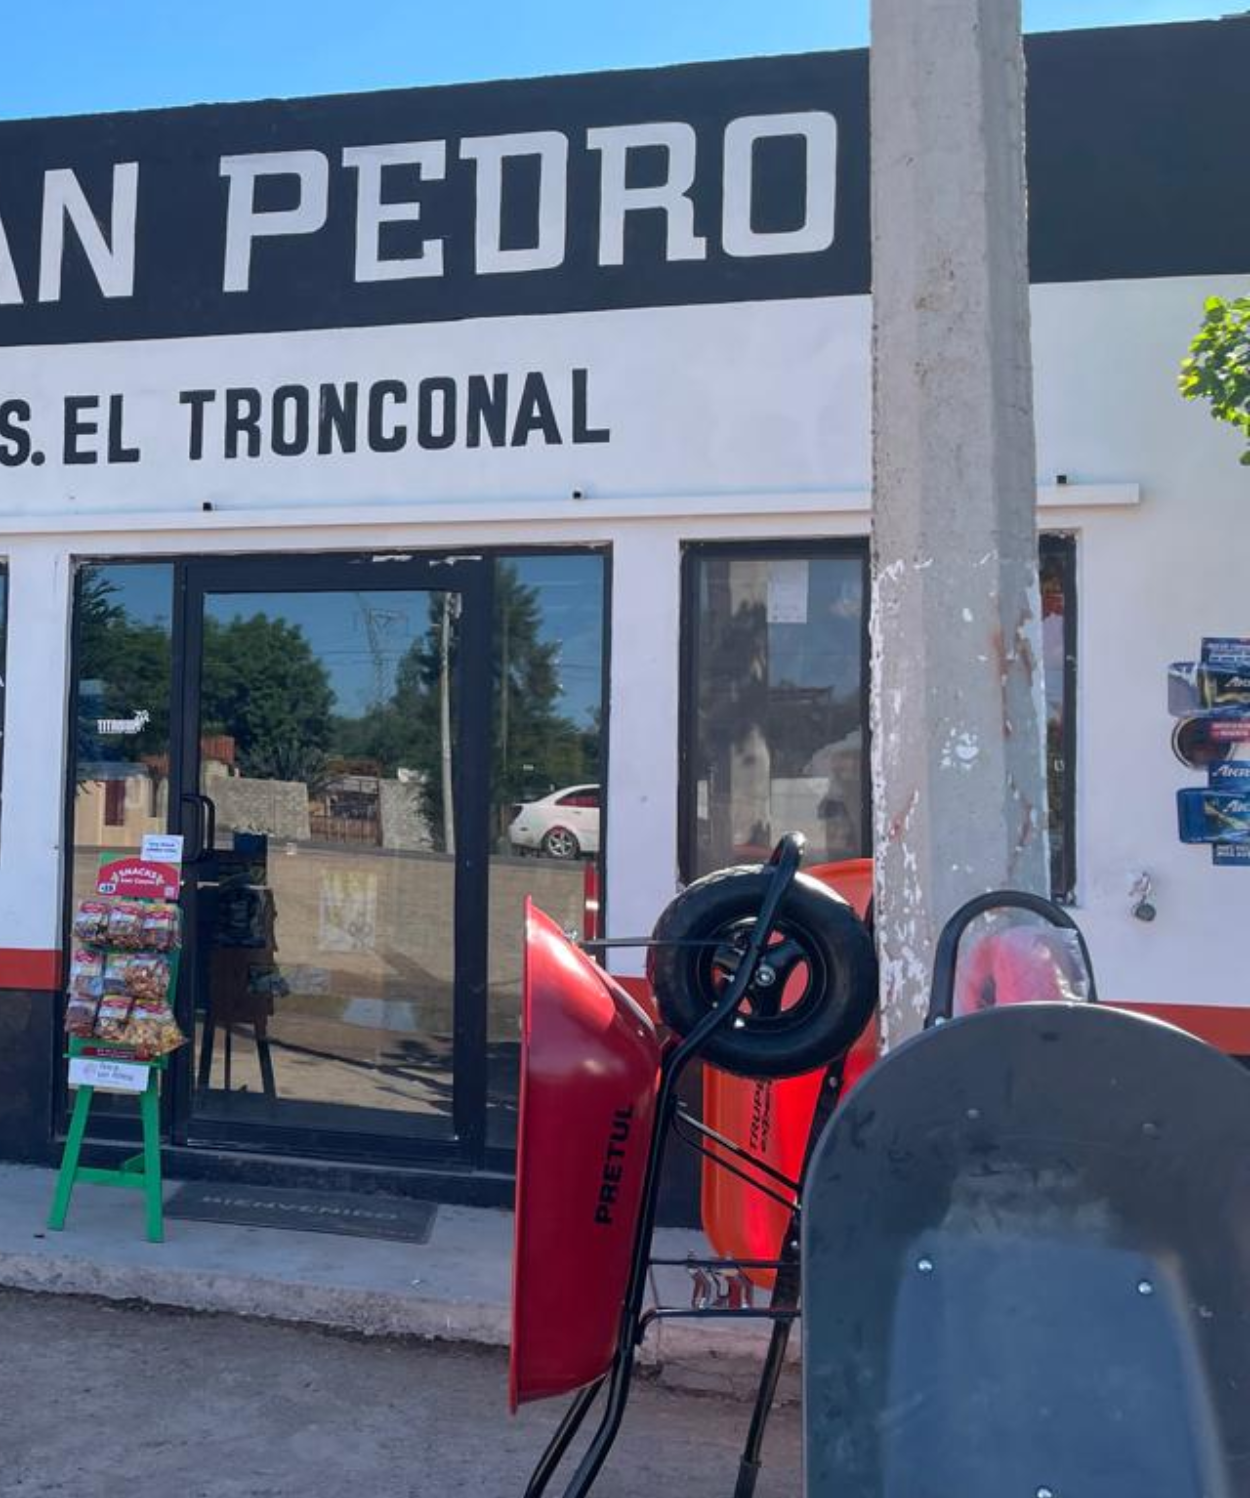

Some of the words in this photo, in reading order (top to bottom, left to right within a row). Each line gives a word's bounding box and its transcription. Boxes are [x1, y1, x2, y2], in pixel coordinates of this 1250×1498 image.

[220, 111, 838, 293] PEDRO
[64, 395, 140, 465] EL
[179, 369, 610, 461] TRONCONAL
[593, 1106, 634, 1226] PRETUL
